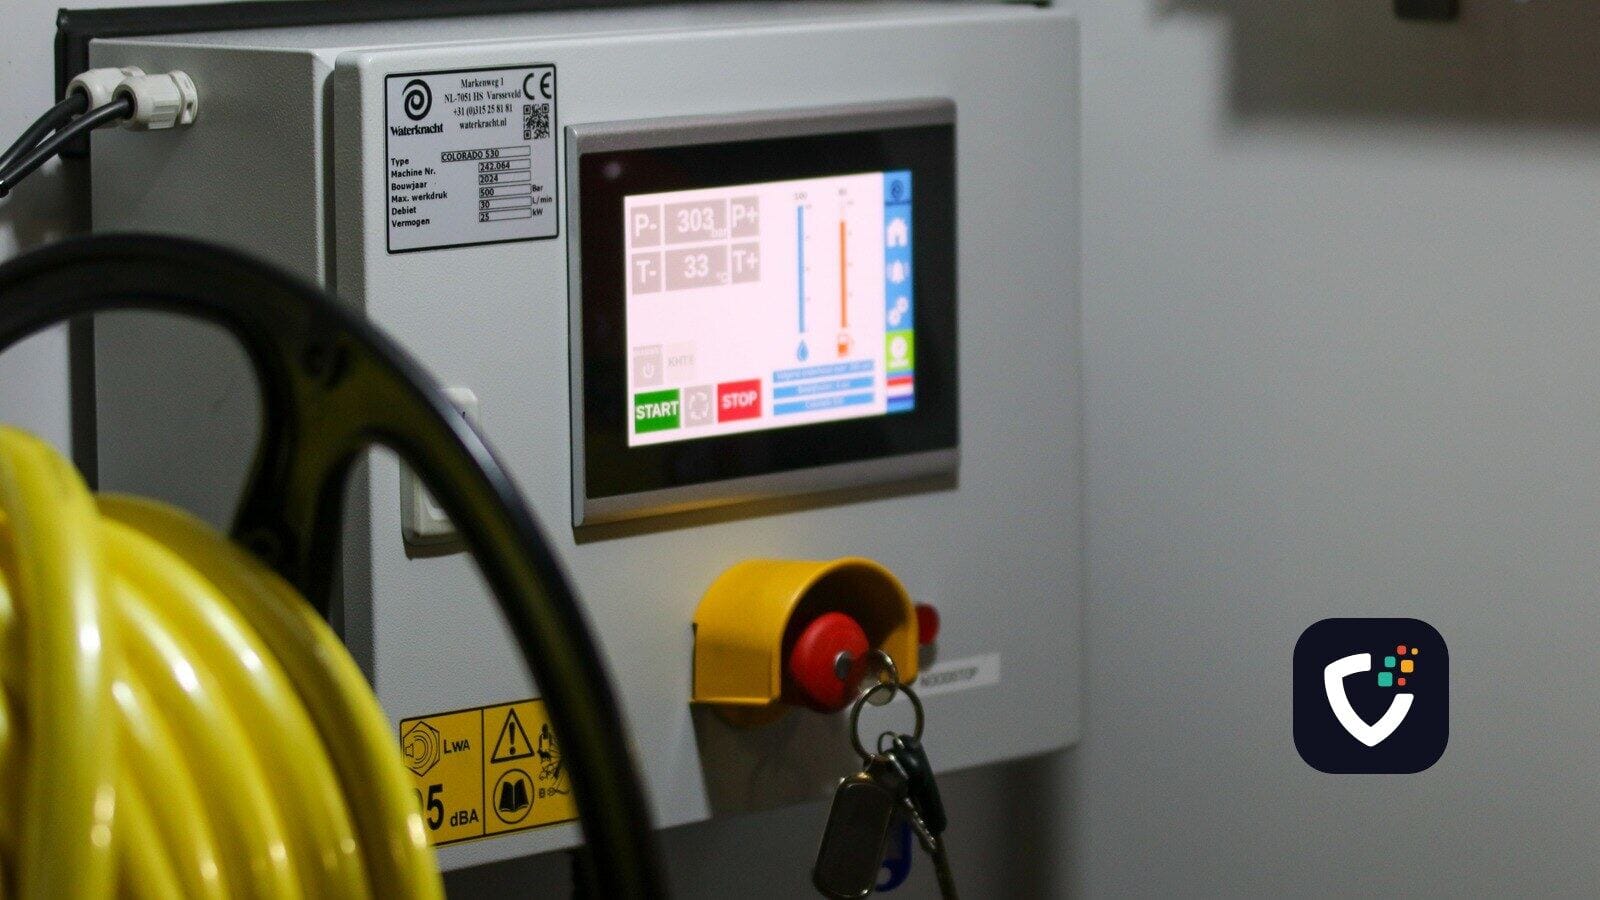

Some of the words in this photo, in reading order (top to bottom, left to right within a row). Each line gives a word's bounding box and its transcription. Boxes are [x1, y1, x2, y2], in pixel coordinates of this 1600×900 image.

[461, 78, 498, 89] Markenweg
[500, 78, 504, 86] 1
[523, 71, 552, 100] CE
[444, 93, 471, 103] NL-7051
[473, 91, 484, 101] HS
[486, 89, 521, 100] Varsseveld
[453, 107, 465, 116] +31
[466, 105, 487, 116] (0)315
[487, 105, 496, 113] 25
[496, 104, 504, 113] 81
[505, 103, 513, 112] 81
[390, 123, 444, 136] Waterkracht
[459, 118, 507, 129] waterkracht.nl
[391, 157, 410, 167] Type
[441, 151, 483, 162] COLORADO
[485, 150, 500, 158] 530
[391, 168, 423, 178] Machine
[425, 167, 436, 176] Nr.
[480, 161, 511, 171] 242.064
[391, 181, 428, 191] Bouwjaar
[480, 174, 499, 183] 2024
[391, 194, 410, 203] Max.
[411, 190, 448, 202] werkdruk
[480, 188, 495, 197] 500
[532, 184, 544, 192] Bar
[391, 206, 417, 215] Debiet
[480, 200, 490, 209] 30
[732, 203, 759, 228] P+
[391, 217, 430, 228] Vermogen
[480, 212, 490, 222] 25
[532, 208, 544, 217] kW
[634, 213, 658, 237] P-
[678, 207, 715, 233] 303
[636, 259, 657, 283] T-
[684, 253, 709, 279] 33
[732, 249, 759, 274] T+
[721, 390, 758, 410] STOP
[636, 400, 679, 420] START
[450, 808, 479, 827] dBA
